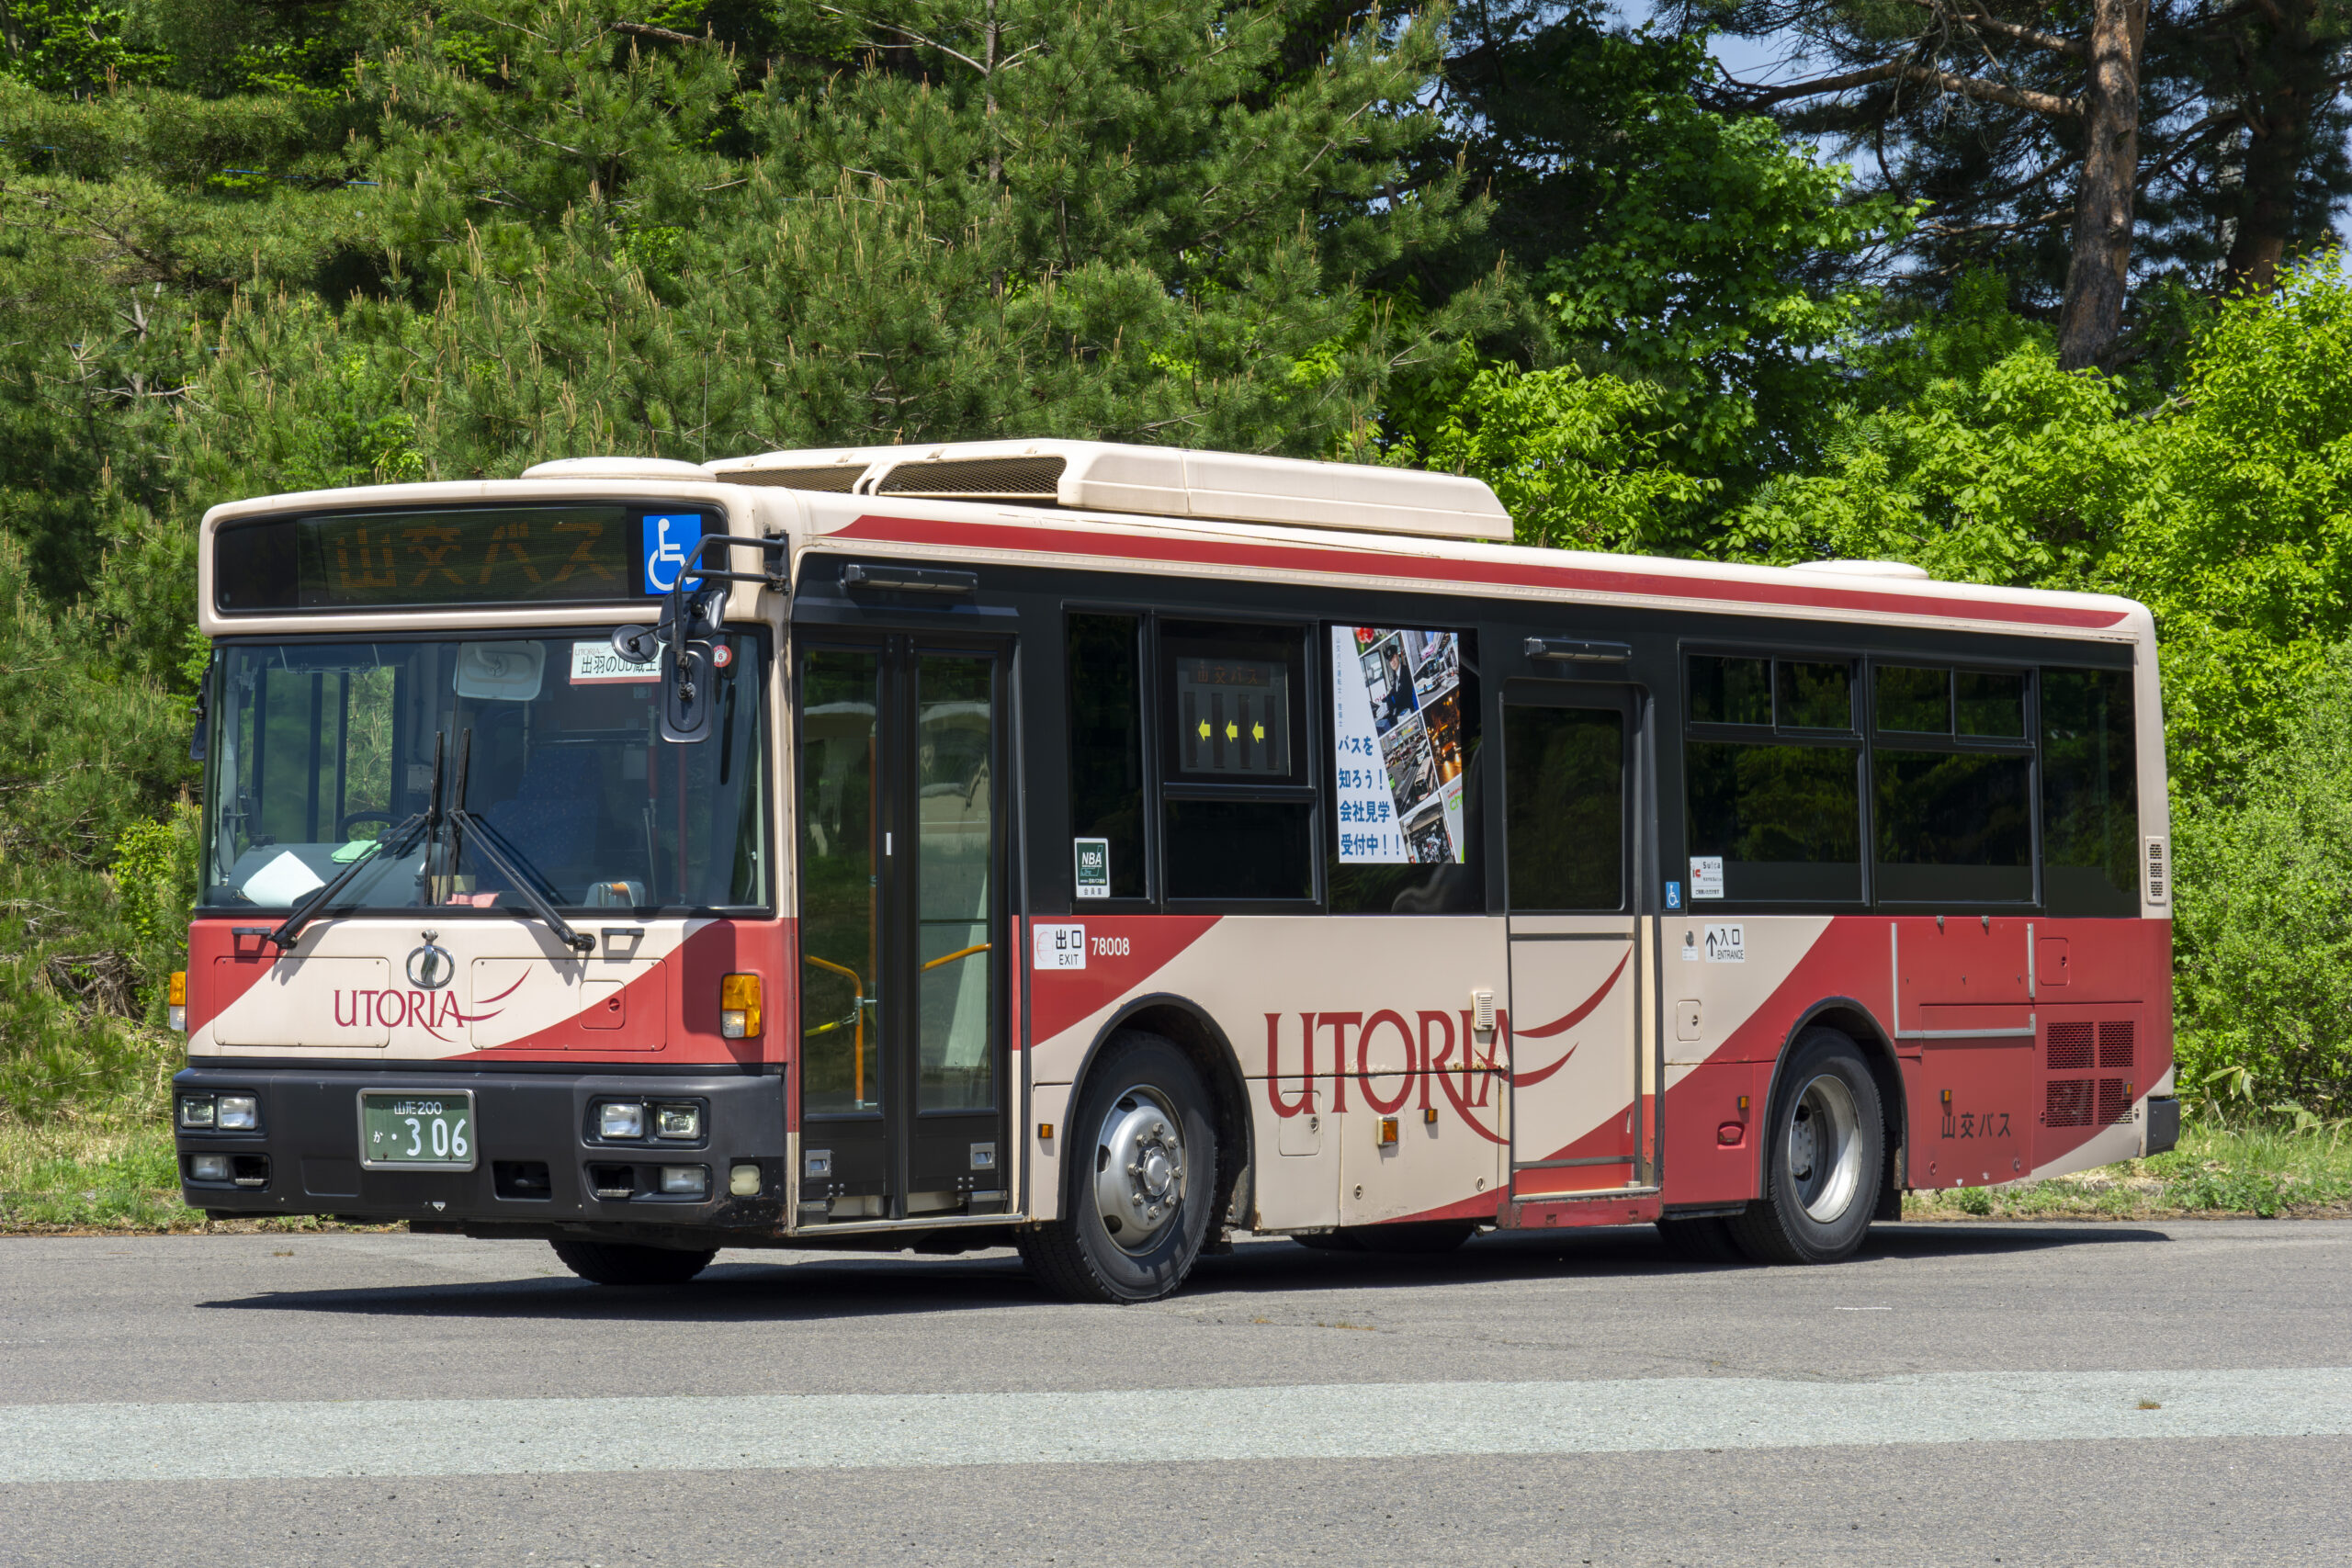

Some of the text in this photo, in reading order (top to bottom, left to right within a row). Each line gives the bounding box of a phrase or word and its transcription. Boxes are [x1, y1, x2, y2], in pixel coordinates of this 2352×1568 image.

[336, 521, 616, 588] 山交バス
[1338, 735, 1374, 756] バスを
[1338, 768, 1383, 791] 知ろう！
[1340, 800, 1391, 823] 会社見学
[1341, 833, 1400, 856] 受付中！！
[1081, 852, 1102, 865] NBA
[1056, 929, 1082, 950] 出口
[1091, 937, 1130, 956] 78008
[1720, 928, 1740, 946] 入口
[1058, 953, 1079, 965] EXIT
[1716, 949, 1745, 960] ENTRANCE
[334, 988, 482, 1043] UTORIA
[1264, 1009, 1534, 1145] UTORIA
[1941, 1111, 2011, 1139] 山交バス
[373, 1130, 384, 1144] か
